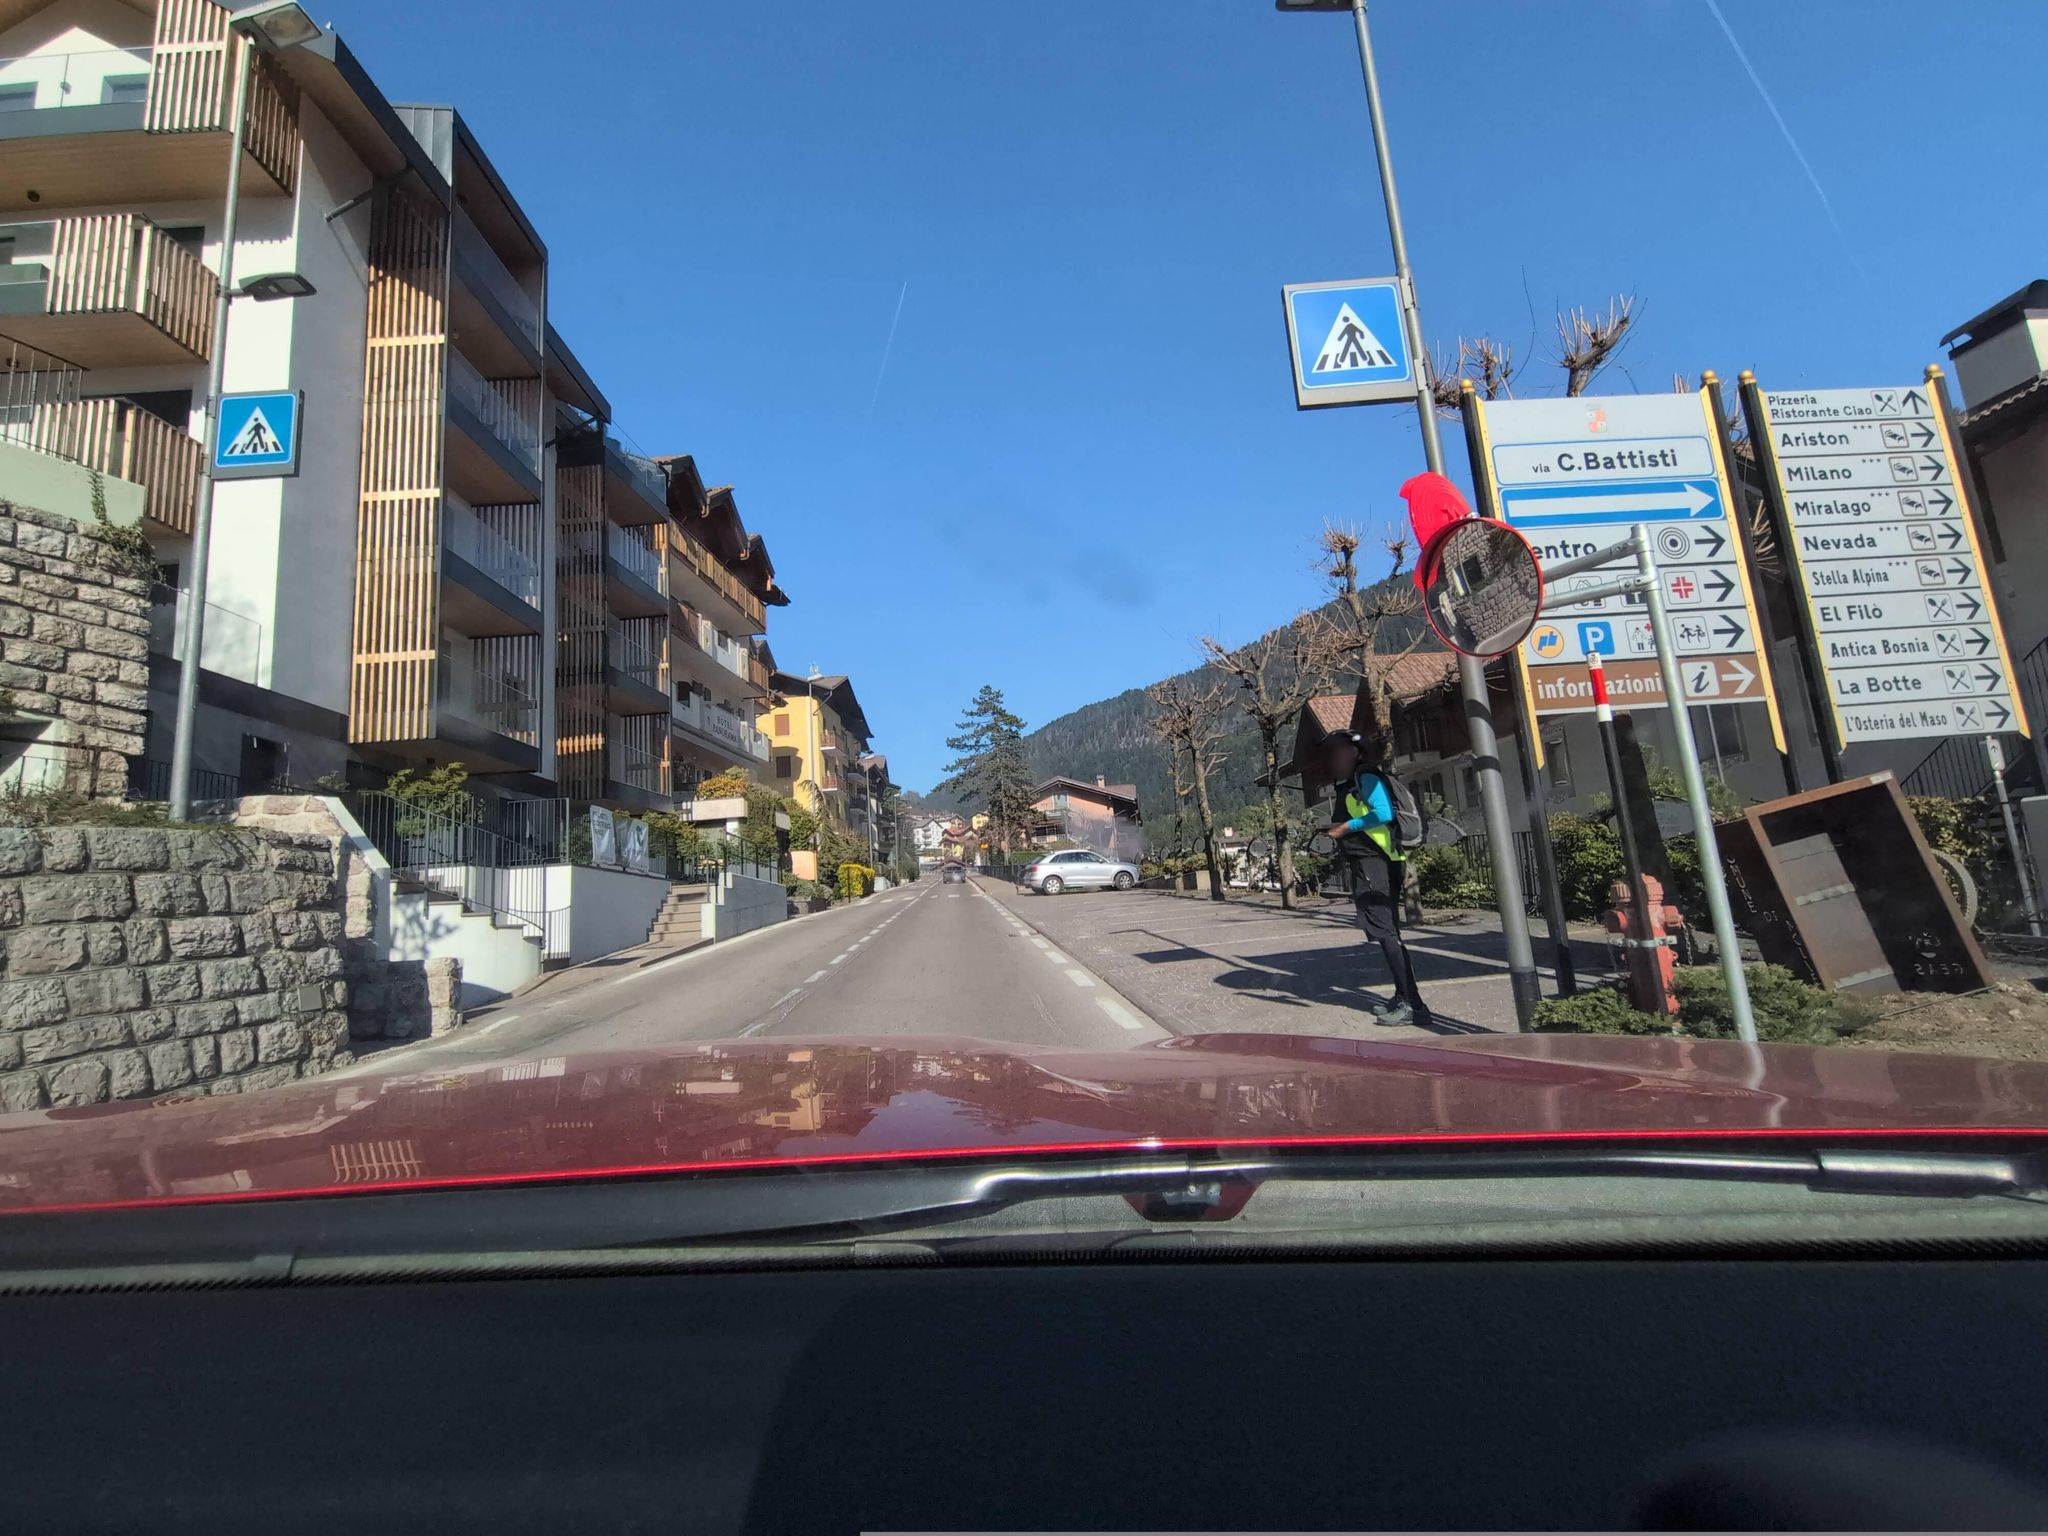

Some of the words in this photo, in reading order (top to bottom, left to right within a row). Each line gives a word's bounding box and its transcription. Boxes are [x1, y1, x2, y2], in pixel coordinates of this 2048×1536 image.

[1768, 395, 1817, 406] Pizzeria
[1771, 406, 1840, 419] Ristorante
[1843, 405, 1873, 417] Ciao
[1781, 431, 1850, 448] Ariston
[1531, 463, 1551, 474] via
[1556, 448, 1678, 472] C.Battisti
[1787, 466, 1852, 482] Milano
[1794, 499, 1872, 517] Miralago
[1532, 540, 1598, 559] entro
[1802, 533, 1878, 551] Nevada
[1812, 570, 1851, 586] Stella
[1852, 568, 1890, 587] Alpina
[1819, 605, 1842, 622] El
[1846, 603, 1883, 621] Filò
[1830, 641, 1877, 658] Antica
[1881, 638, 1930, 655] Bosnia
[1837, 679, 1862, 695] La
[1866, 675, 1922, 692] Botte
[1844, 715, 1896, 732] L'Osteria
[1899, 715, 1917, 729] del
[1920, 712, 1948, 727] Maso
